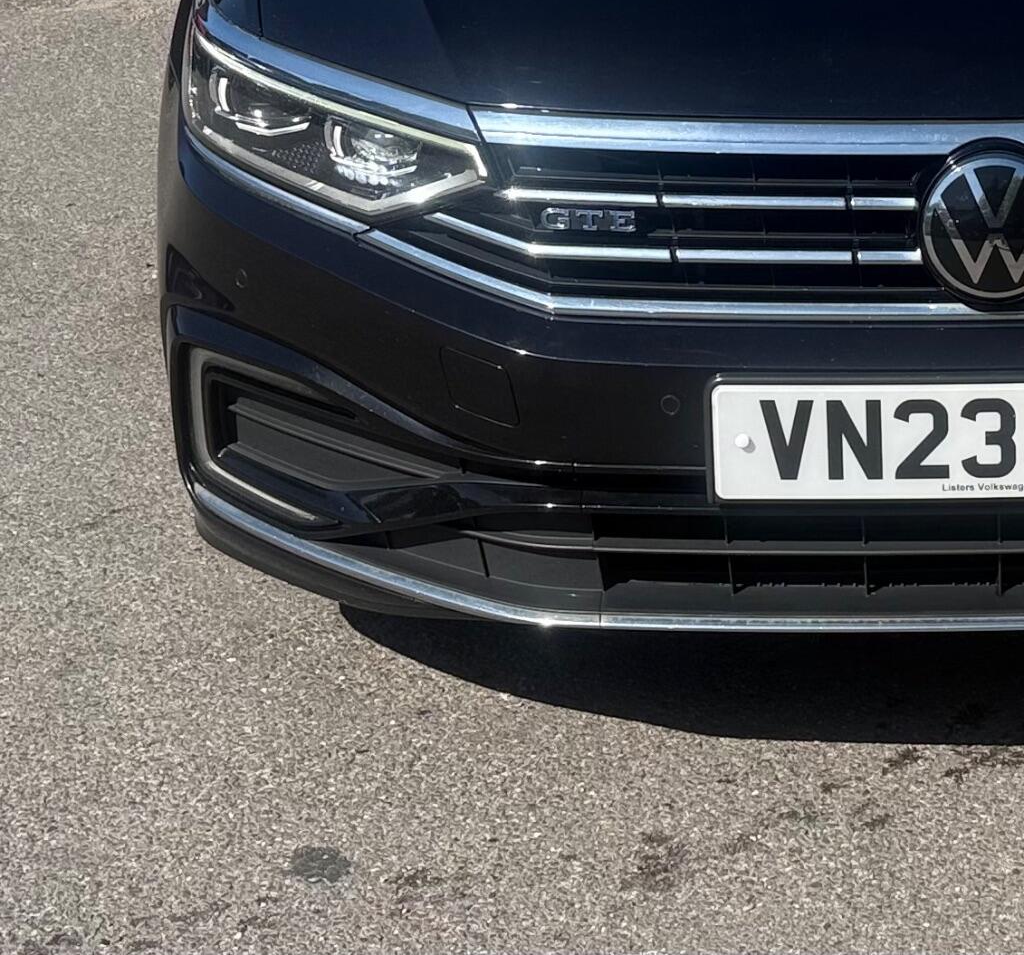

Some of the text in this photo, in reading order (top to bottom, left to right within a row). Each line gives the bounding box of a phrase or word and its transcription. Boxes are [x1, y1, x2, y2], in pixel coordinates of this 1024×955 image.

[540, 207, 636, 232] GTE
[759, 398, 1016, 480] VN23
[942, 483, 975, 491] Listers
